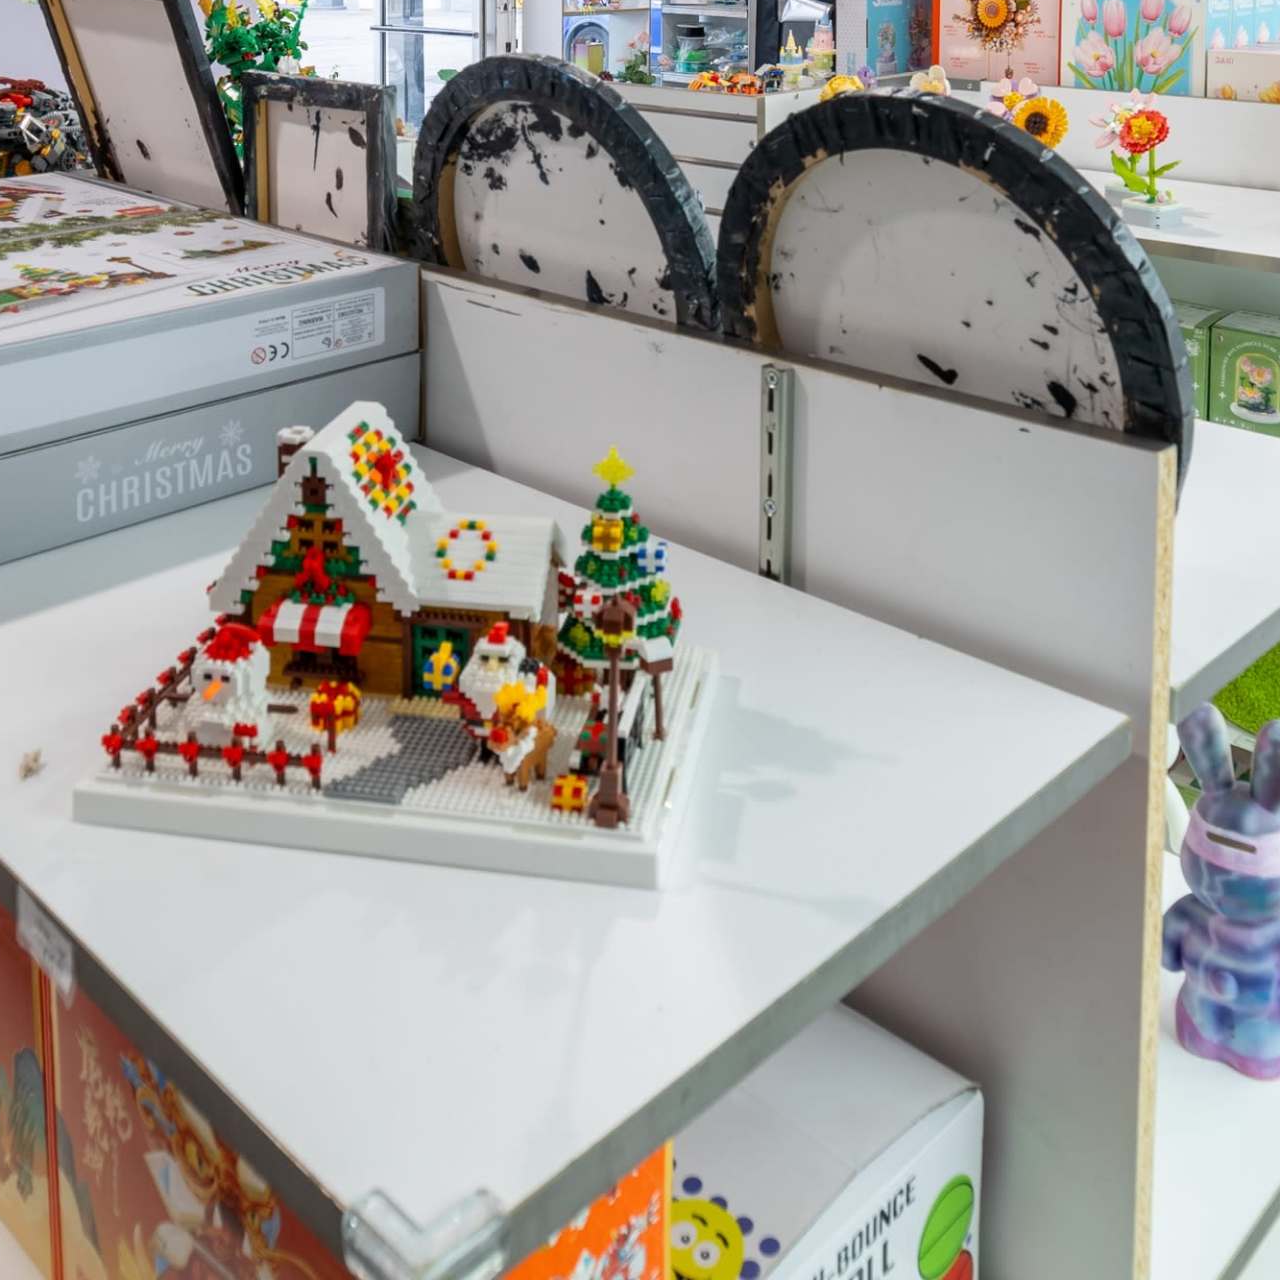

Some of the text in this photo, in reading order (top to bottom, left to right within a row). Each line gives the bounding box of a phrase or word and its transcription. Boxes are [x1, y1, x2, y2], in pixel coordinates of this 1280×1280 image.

[186, 254, 370, 297] CHRISTMAS
[134, 435, 205, 466] Merry
[75, 443, 253, 523] CHRISTMAS
